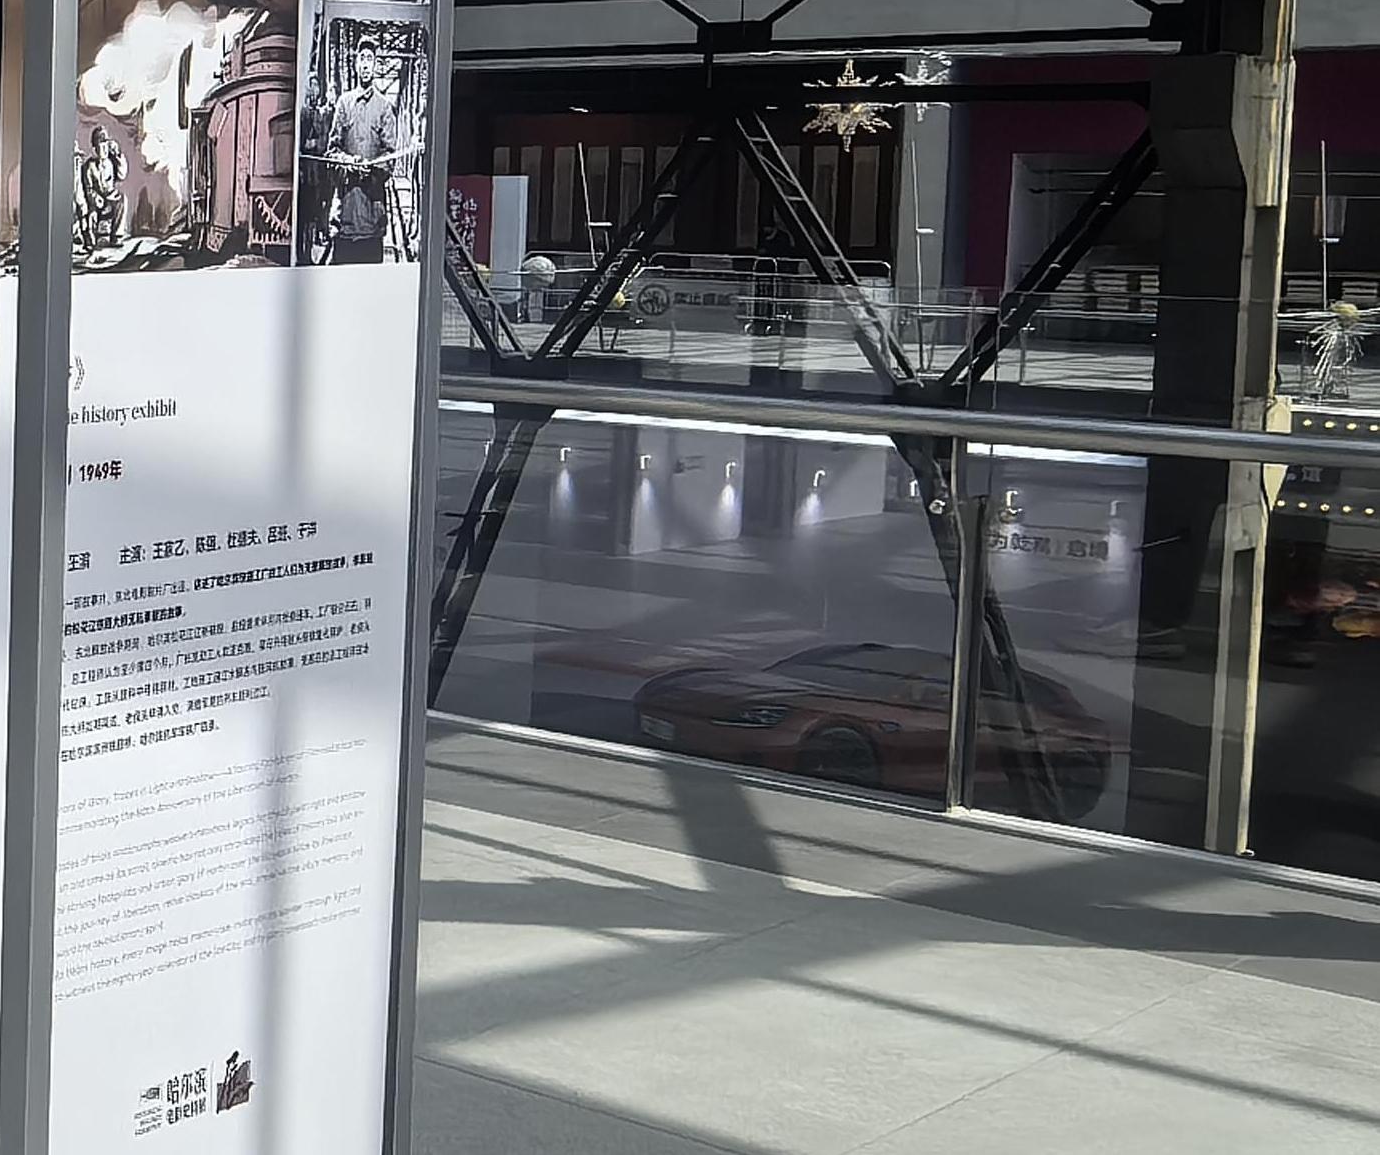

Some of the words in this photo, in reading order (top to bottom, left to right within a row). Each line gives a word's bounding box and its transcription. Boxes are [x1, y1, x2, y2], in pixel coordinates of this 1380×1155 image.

[81, 402, 131, 427] history
[131, 396, 178, 421] exhibit
[79, 459, 124, 484] 1949年
